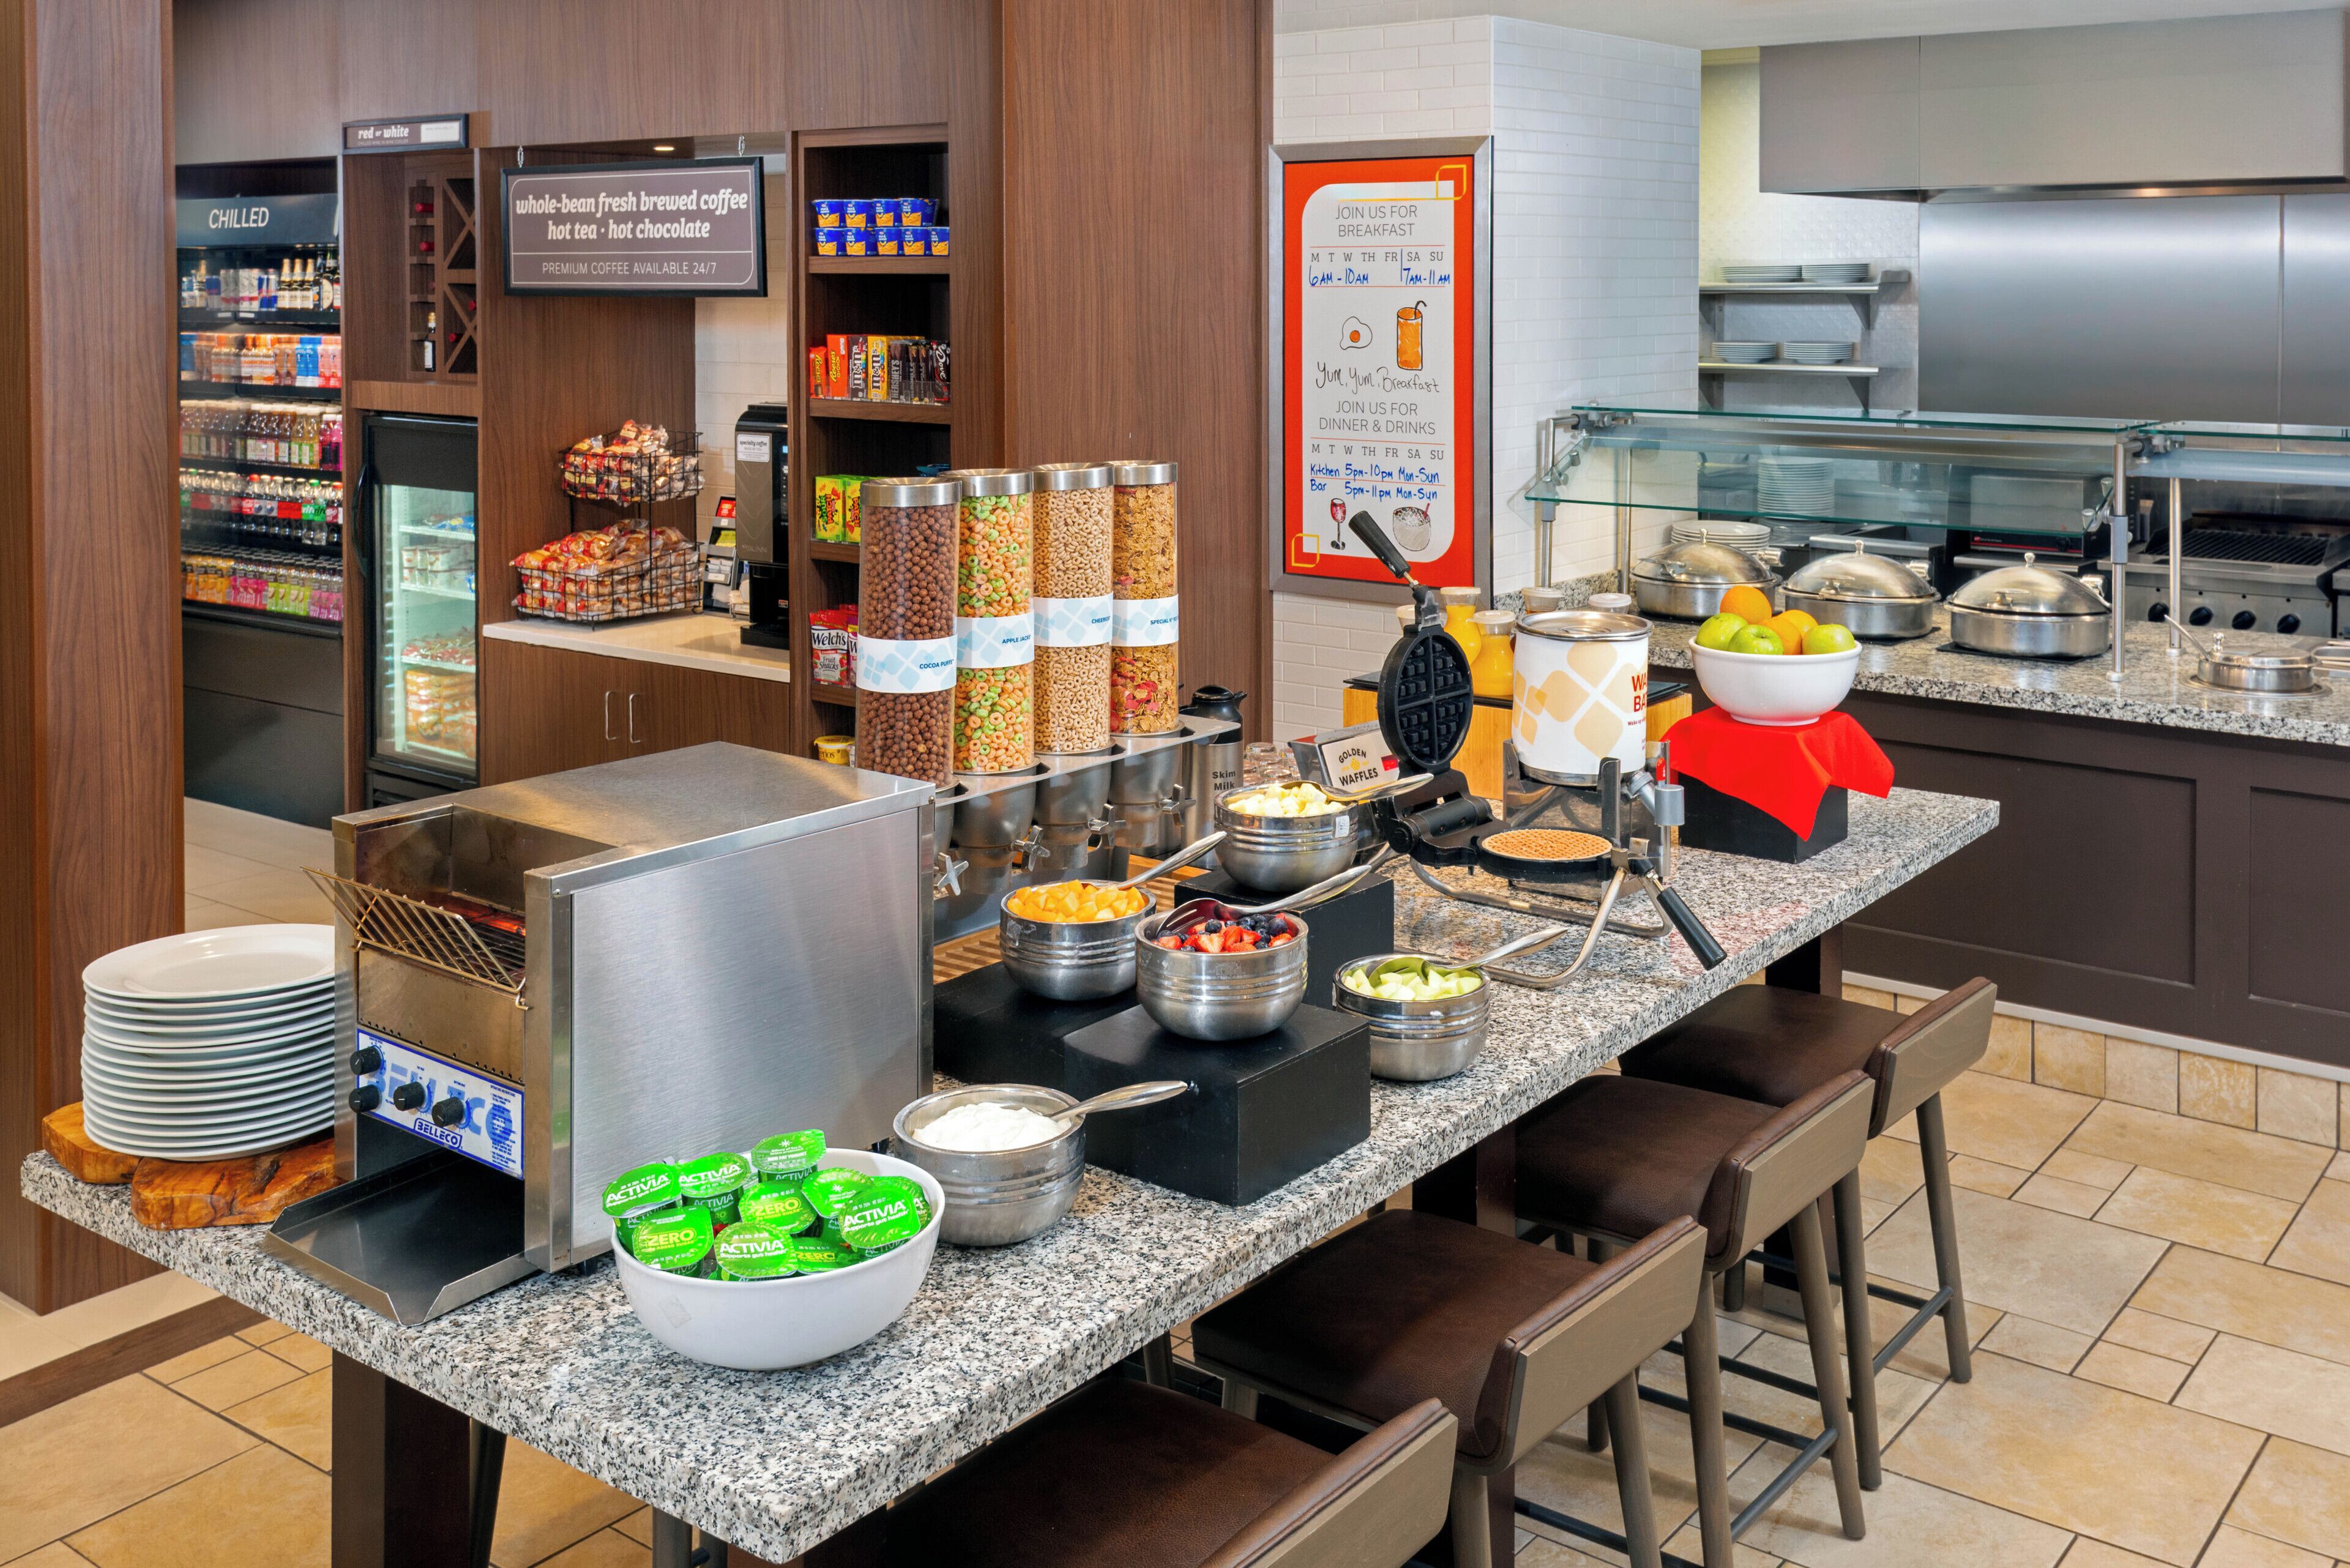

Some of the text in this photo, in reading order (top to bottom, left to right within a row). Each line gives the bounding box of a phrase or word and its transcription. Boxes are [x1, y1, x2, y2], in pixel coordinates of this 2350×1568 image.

[358, 127, 374, 140] red
[383, 125, 409, 138] white
[516, 189, 748, 218] whole-bean fresh brewed coffee
[209, 207, 269, 229] CHILLED
[1335, 204, 1418, 220] JOIN US FOR
[548, 217, 711, 240] hot tea hot chocolate
[1338, 223, 1416, 237] BREAKFAST
[1311, 252, 1444, 263] M T W TH FR SA SU
[542, 262, 717, 275] PREMIUM COFFEE AVAILABLE 24/7
[1335, 401, 1418, 416] JOIN US FOR
[1319, 417, 1436, 435] DINNER & DRINKS
[1311, 444, 1444, 460] M T W TH FR SA SU
[1310, 463, 1340, 477] Kitchen
[1310, 479, 1327, 491] Bar
[812, 632, 846, 646] Welch's
[819, 661, 838, 670] Snacks
[1338, 748, 1367, 764] GOLDEN
[1212, 770, 1236, 780] Skim
[1338, 767, 1378, 786] WAFFLES
[1214, 782, 1235, 791] Milk
[417, 1121, 458, 1146] BELLECO
[679, 1164, 741, 1182] ACTIVIA
[605, 1174, 670, 1204] ACTIVIA
[755, 1198, 799, 1217] ZERO
[844, 1200, 906, 1227] ACTIVIA
[646, 1229, 695, 1247] ZERO
[720, 1239, 784, 1254] ACTIVIA
[797, 1252, 835, 1261] ZERO
